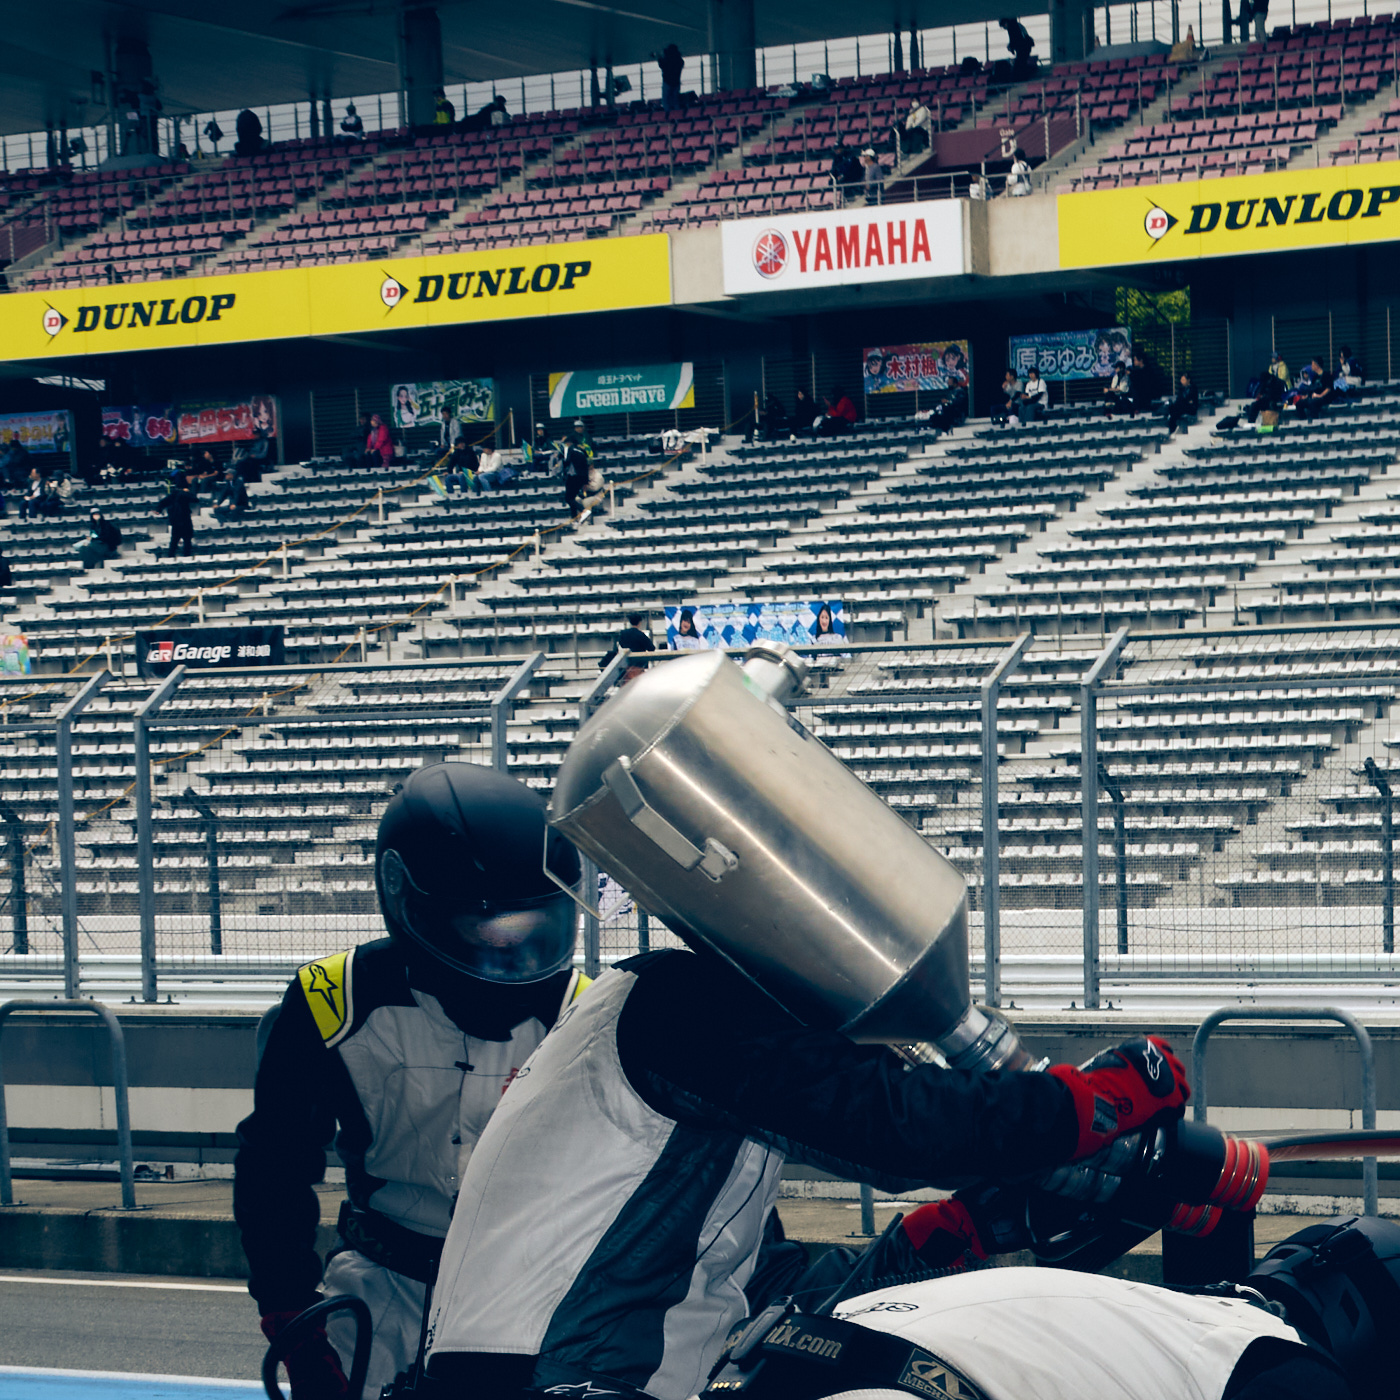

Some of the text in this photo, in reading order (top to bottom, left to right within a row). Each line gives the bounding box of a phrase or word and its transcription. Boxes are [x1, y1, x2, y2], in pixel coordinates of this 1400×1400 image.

[792, 218, 932, 273] YAMAHA
[413, 261, 591, 303] DUNLOP
[73, 293, 236, 332] DUNLOP
[576, 384, 666, 409] Green Brave
[173, 642, 231, 662] Garage
